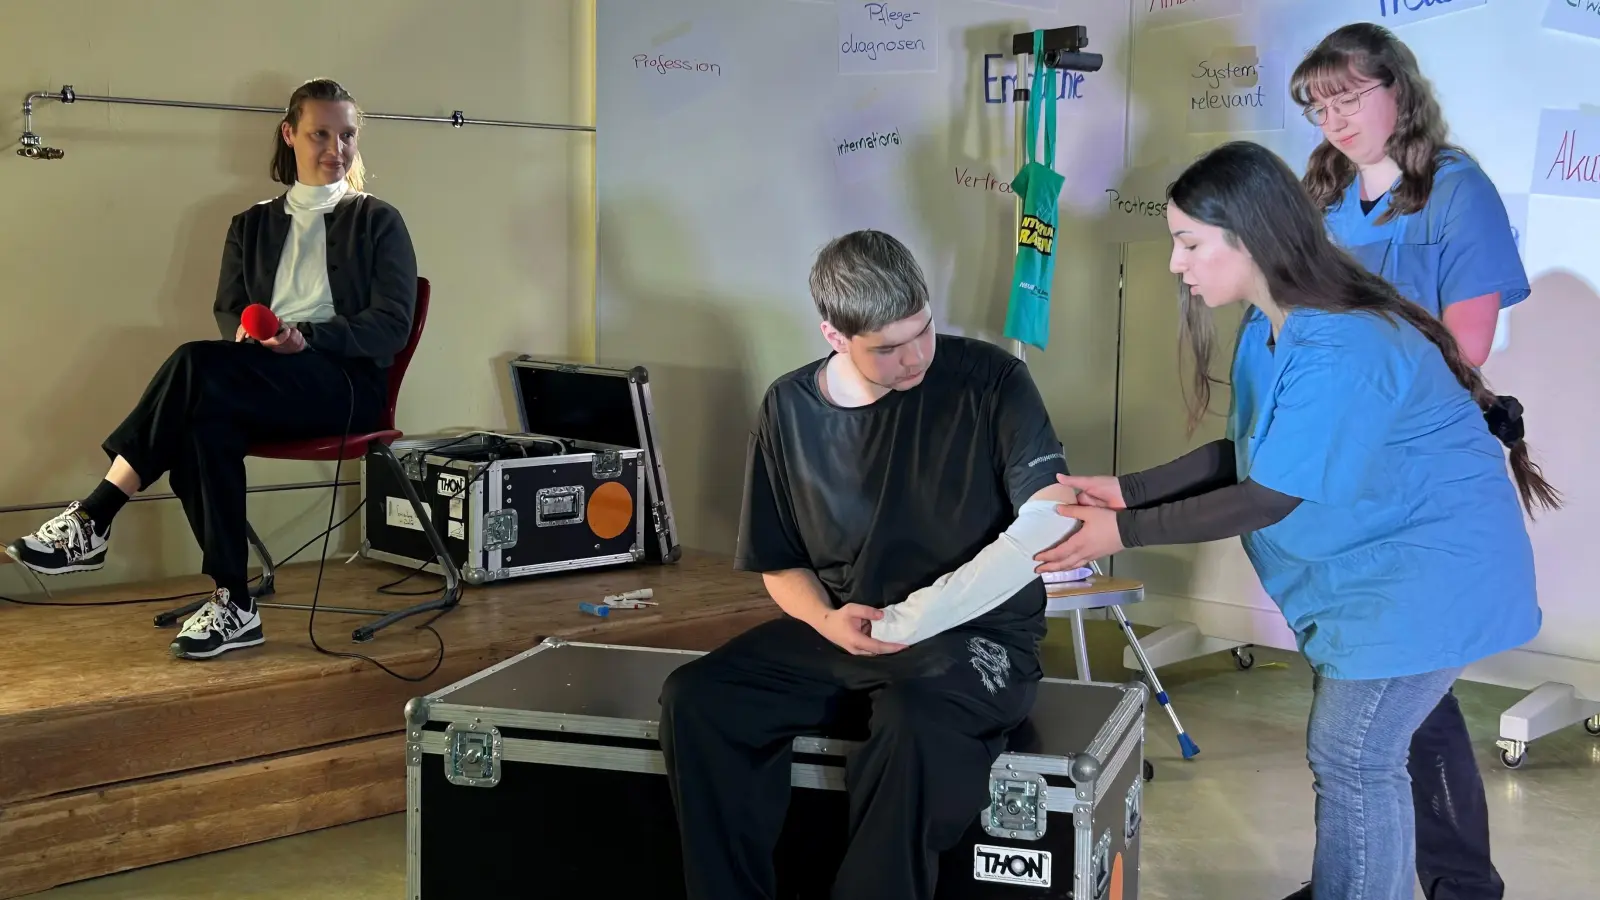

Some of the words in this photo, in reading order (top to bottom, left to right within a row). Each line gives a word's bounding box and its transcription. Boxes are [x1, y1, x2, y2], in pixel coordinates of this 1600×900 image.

[864, 2, 921, 30] Pflege-
[841, 33, 926, 61] diagnosen
[632, 53, 721, 76] Profession
[1191, 86, 1266, 110] relevant
[1546, 129, 1600, 183] Aku
[955, 166, 1014, 195] Vertra
[440, 477, 465, 493] THON
[977, 852, 1043, 879] THON
